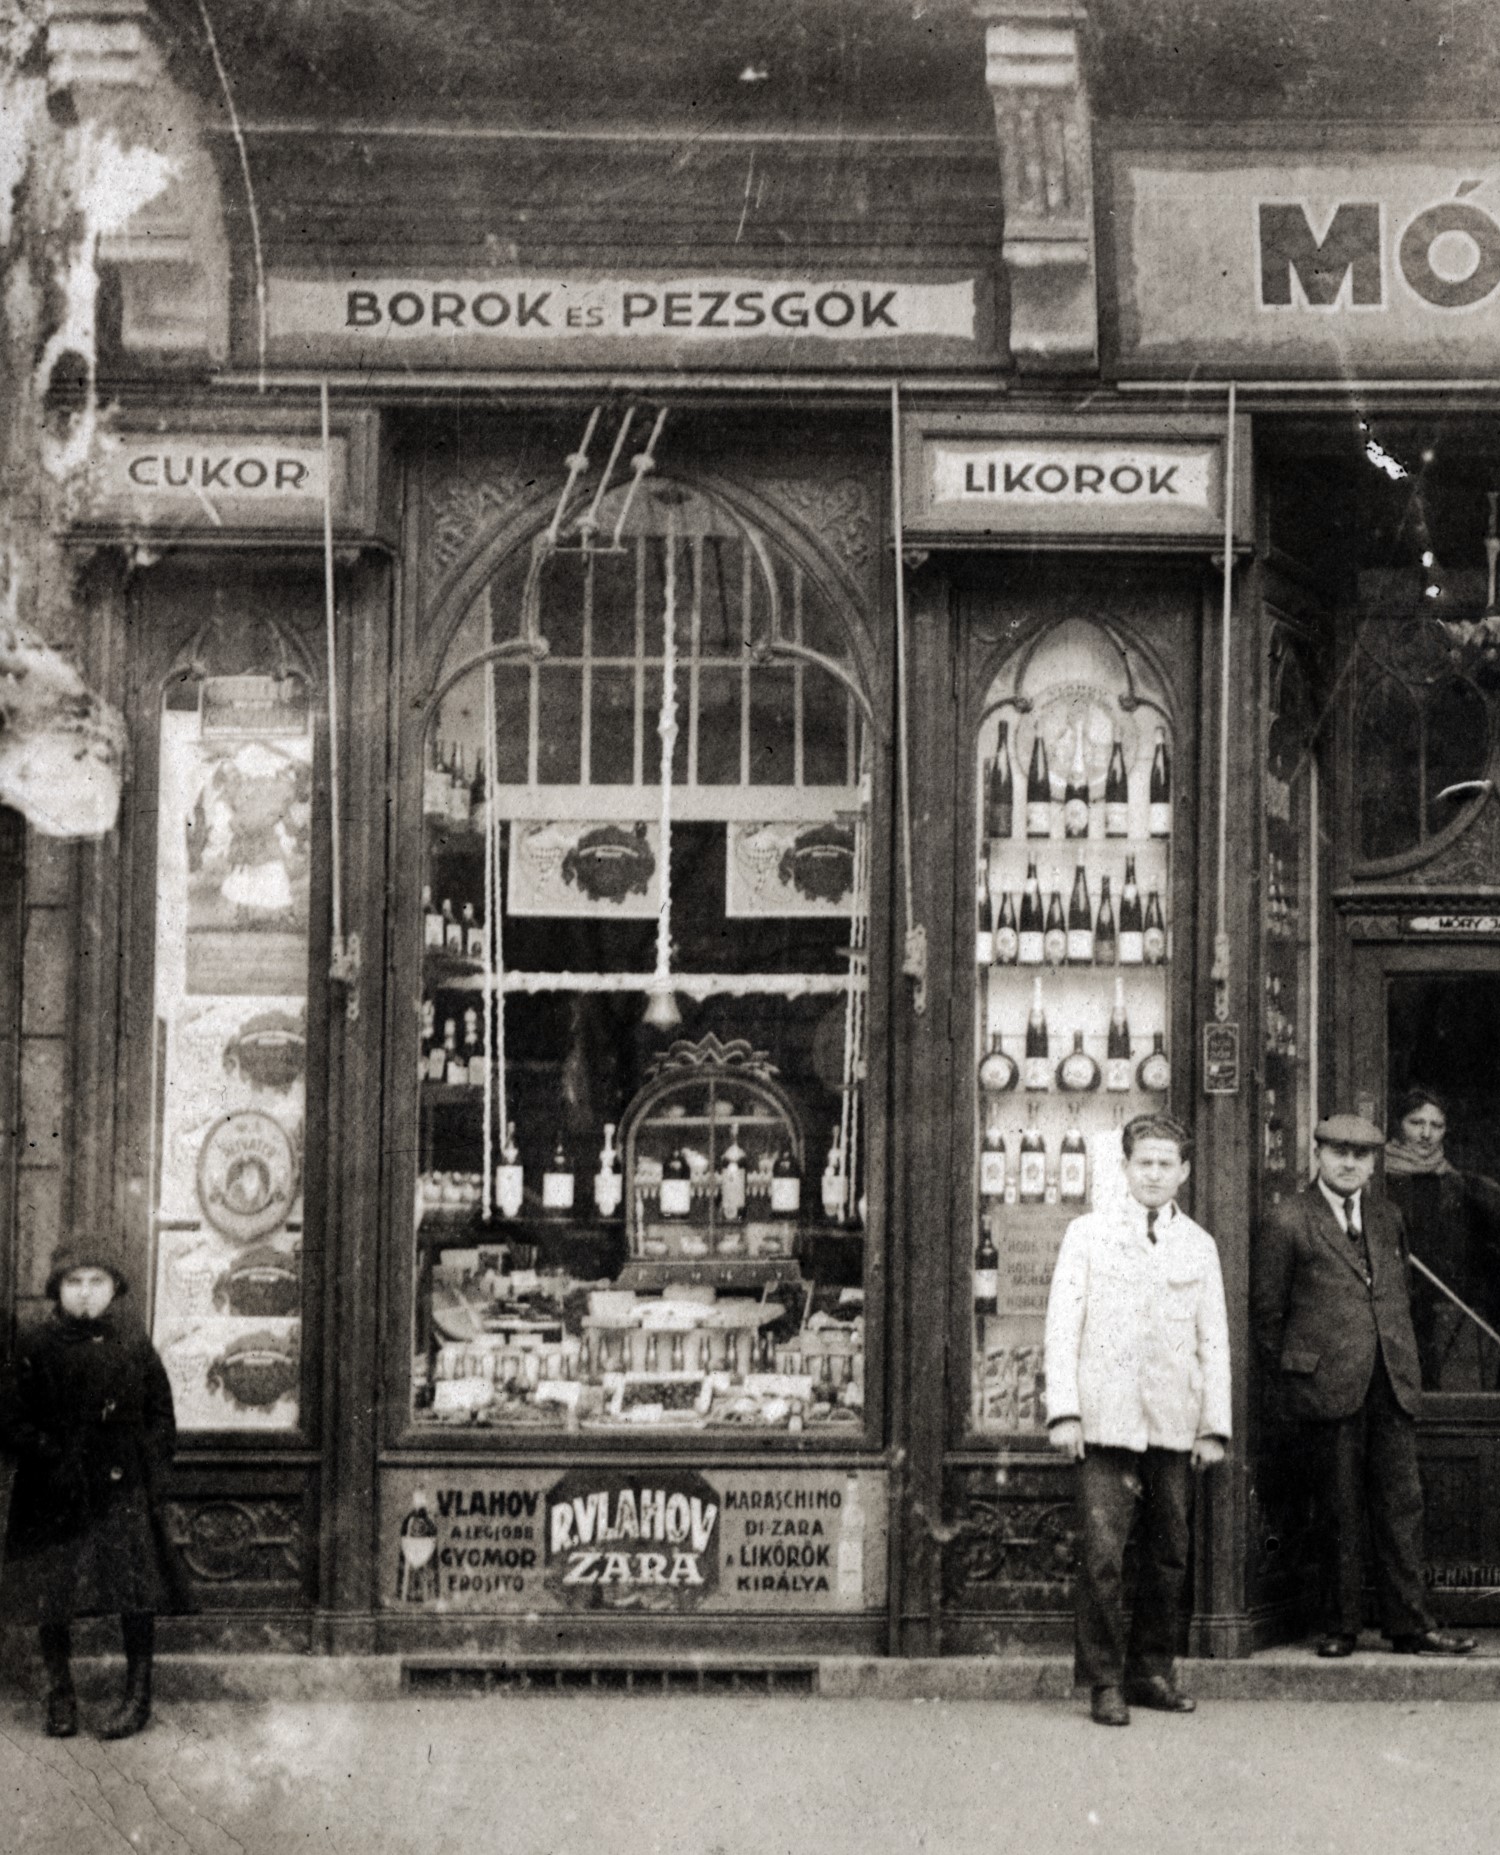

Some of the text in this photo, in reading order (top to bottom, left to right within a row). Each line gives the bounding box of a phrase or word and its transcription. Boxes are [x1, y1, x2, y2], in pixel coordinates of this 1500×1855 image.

[346, 291, 551, 327] BOROK
[128, 456, 306, 489] CUKOR
[437, 1489, 539, 1517] VLAHOV
[725, 1489, 842, 1511] MARASCHINO
[441, 1548, 536, 1568] GYOMOR
[562, 1551, 705, 1584] ZARA
